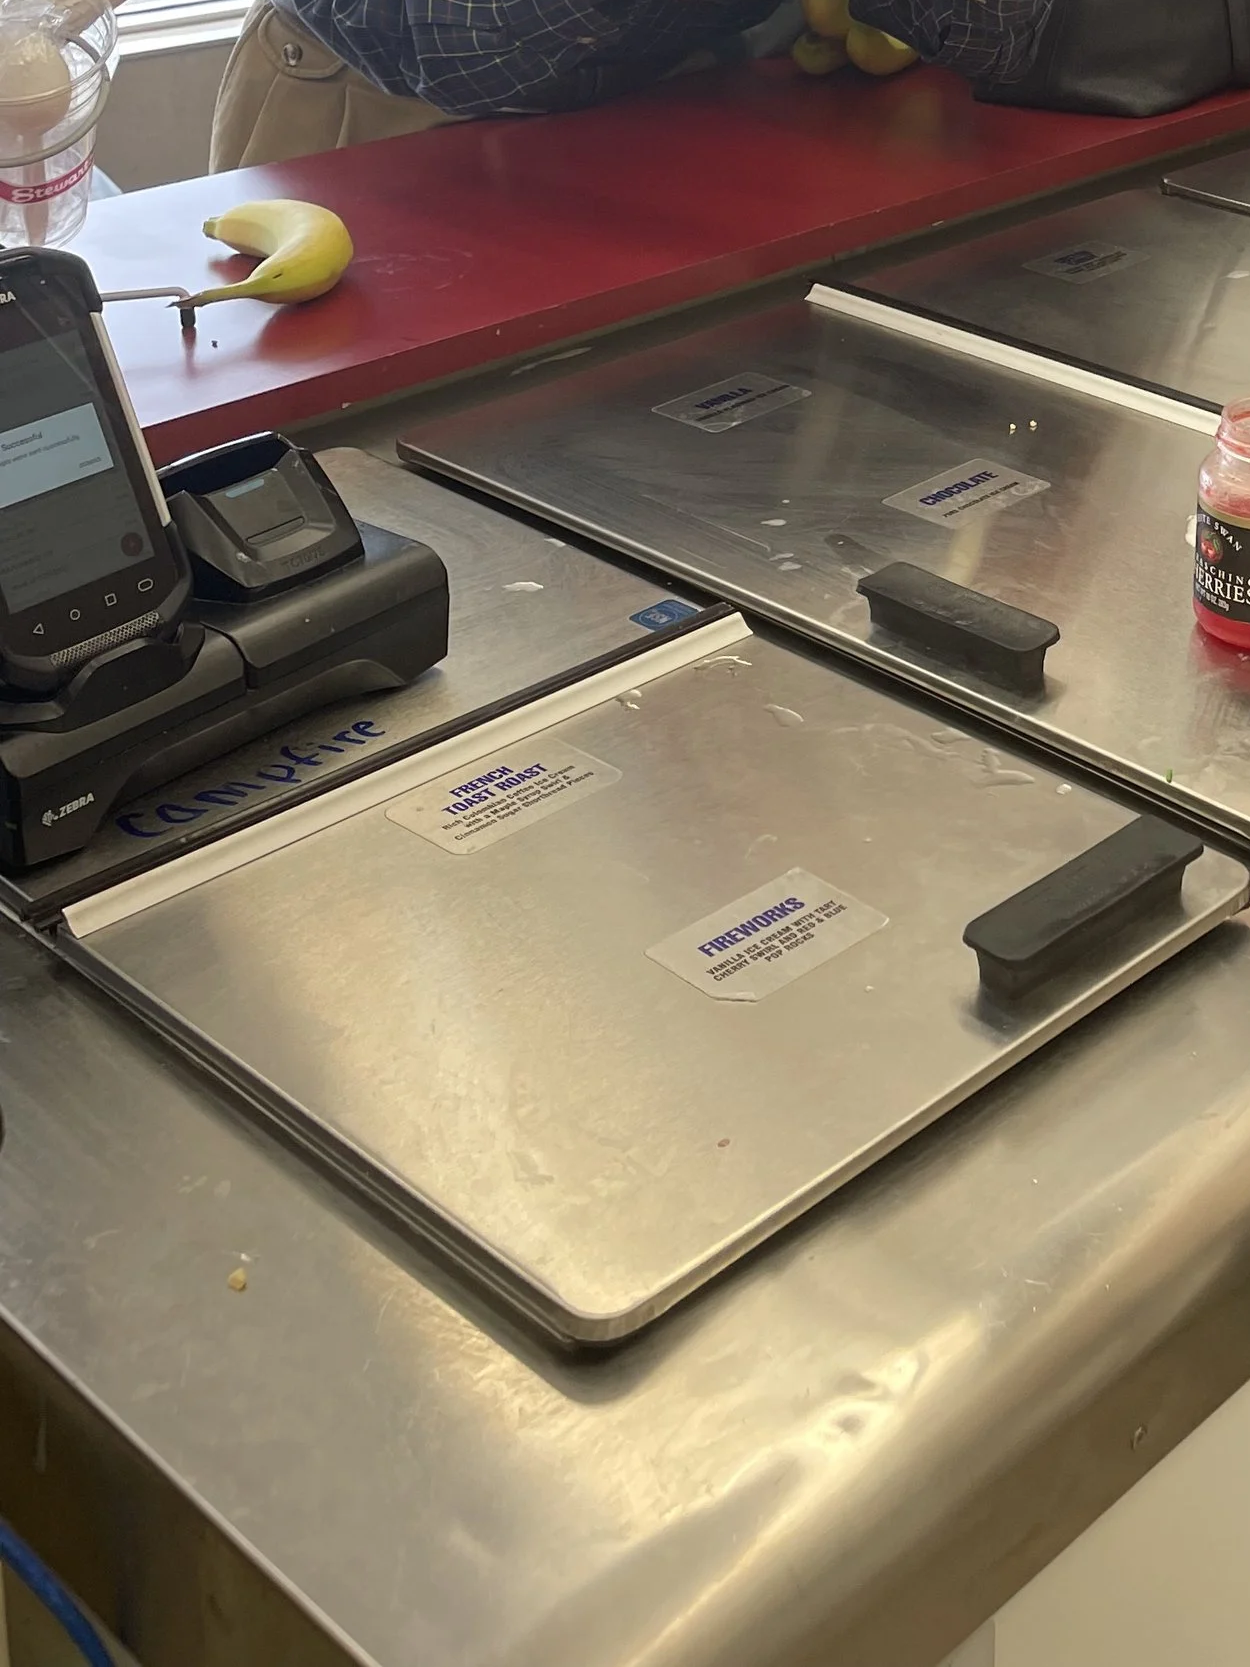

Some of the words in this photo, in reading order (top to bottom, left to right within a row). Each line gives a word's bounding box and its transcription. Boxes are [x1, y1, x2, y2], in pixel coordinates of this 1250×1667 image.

[1, 431, 43, 452] Successful
[919, 470, 1000, 506] CHOCOLATE
[1214, 519, 1243, 552] SWAN
[58, 792, 96, 819] ZEBRA
[441, 787, 497, 816] TOAST
[494, 762, 549, 792] ROAST
[442, 820, 463, 831] Rich
[463, 797, 507, 821] Colombian
[506, 784, 534, 800] Coffee
[534, 776, 548, 787] Ice
[548, 764, 576, 779] Cream
[449, 765, 515, 799] FRENCH
[454, 819, 498, 842] Cinnamon
[497, 805, 522, 821] Sugar
[567, 770, 595, 786] Pieces
[465, 816, 483, 828] with
[490, 800, 517, 817] Maple
[516, 788, 541, 804] Syrup
[540, 778, 562, 790] Swirl
[697, 896, 805, 958] FIREWORKS
[706, 952, 744, 976] VANILLA
[743, 942, 761, 956] ICE
[760, 925, 793, 945] CREAM
[791, 912, 816, 928] WITH
[813, 899, 838, 915] TART
[713, 959, 750, 982] CHERRY
[750, 944, 780, 962] SWIRL
[778, 933, 798, 947] AND
[796, 922, 816, 937] RED
[823, 903, 848, 919] BLUE
[764, 948, 784, 962] POP
[784, 931, 815, 951] ROCKS
